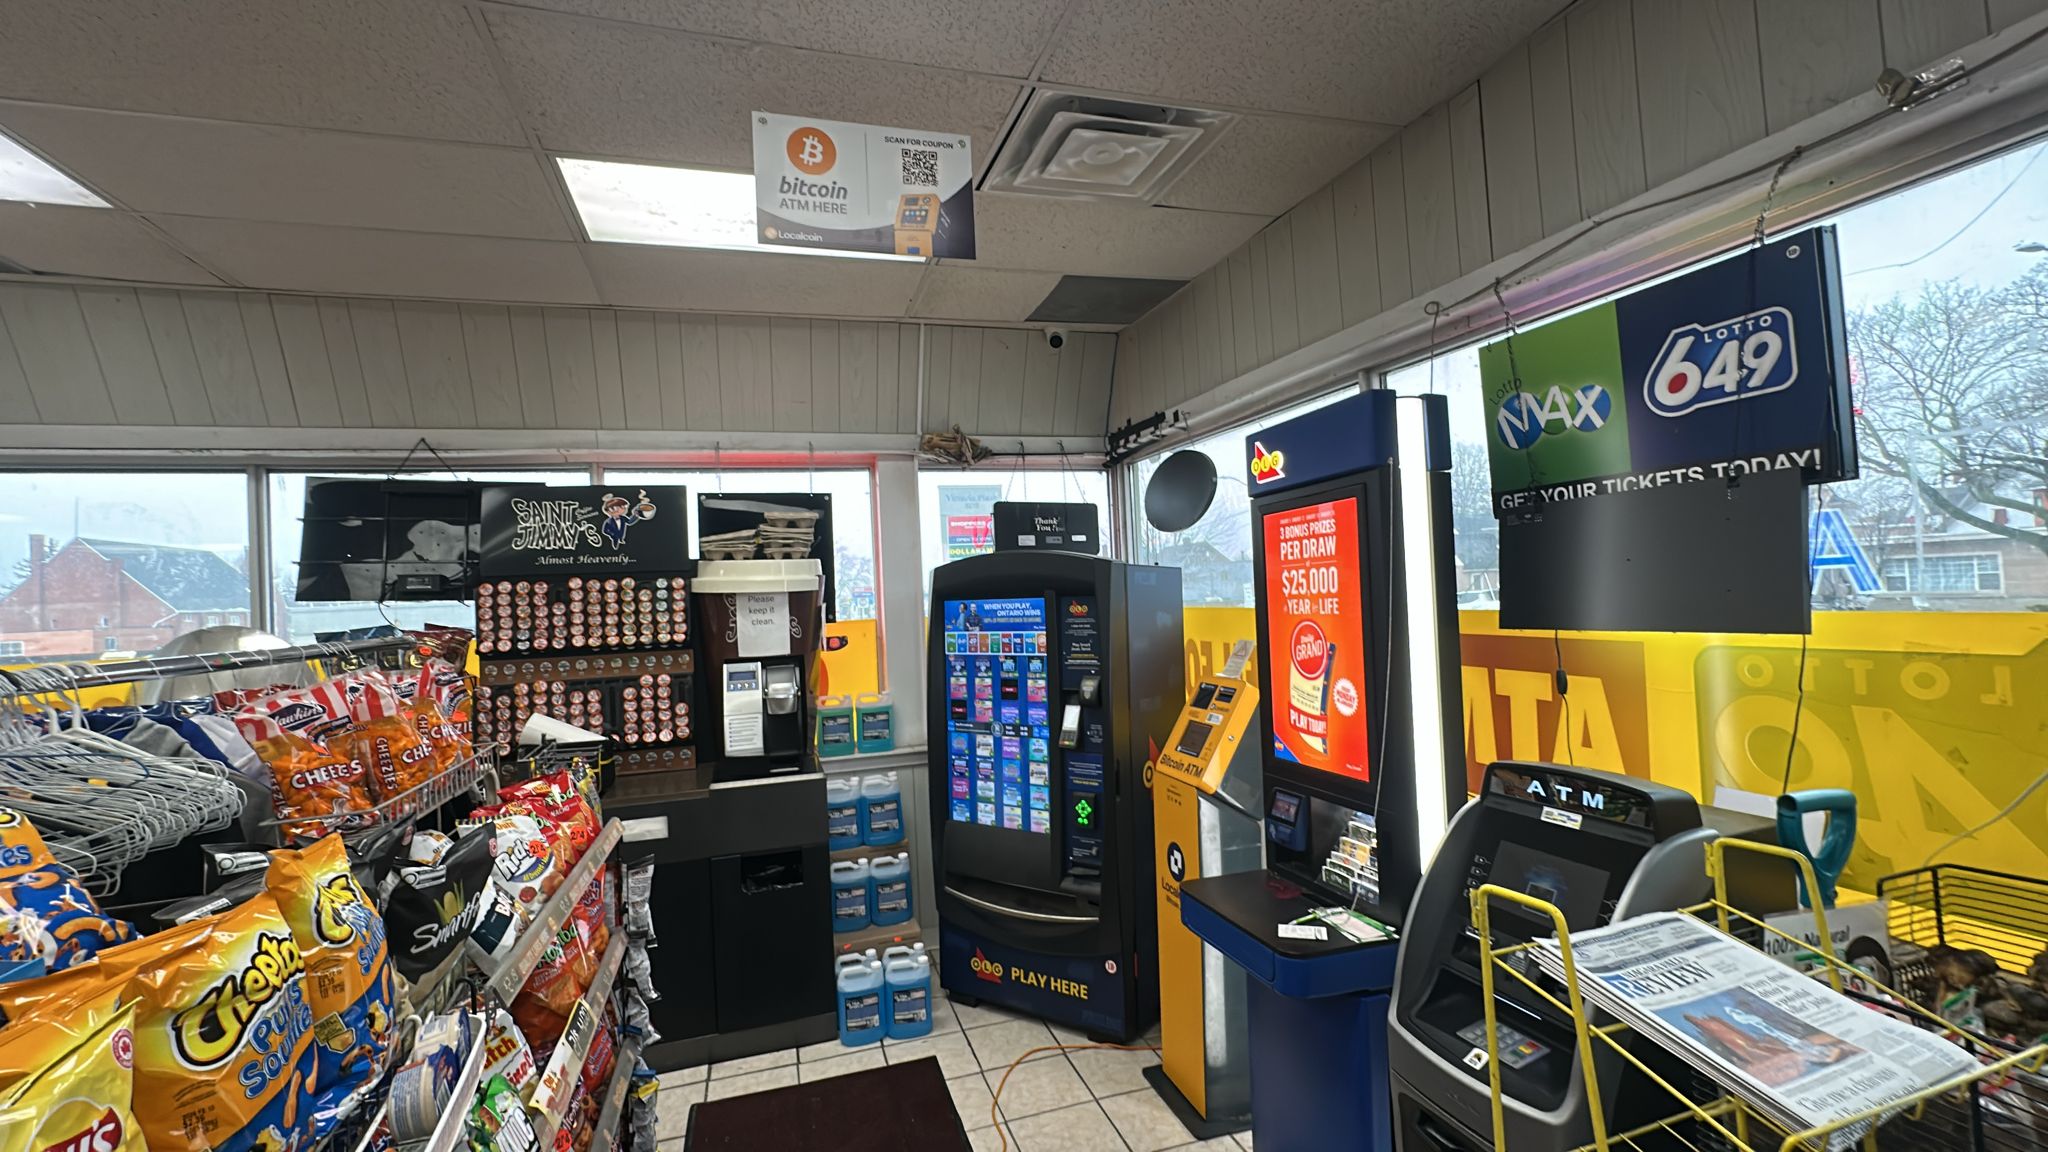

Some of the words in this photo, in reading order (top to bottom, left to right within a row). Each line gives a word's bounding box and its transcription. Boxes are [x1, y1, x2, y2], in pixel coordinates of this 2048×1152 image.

[884, 136, 905, 145] SCAN
[906, 138, 920, 147] FOR
[922, 140, 954, 149] COUPON
[778, 175, 848, 200] bitcoin
[779, 198, 810, 211] ATM
[813, 202, 847, 215] HERE
[777, 230, 823, 242] Localcoin
[1704, 315, 1773, 343] LOTTO
[1653, 330, 1783, 407] 649
[1489, 377, 1522, 407] Lotto
[1497, 384, 1605, 449] MAX
[1251, 450, 1284, 476] OLG
[1540, 482, 1598, 502] YOUR
[1602, 466, 1704, 494] TICKETS
[1711, 448, 1822, 477] TODAY!
[511, 498, 579, 525] SAINT
[1034, 517, 1059, 525] Thank
[512, 520, 602, 550] JIMMY'S
[1280, 527, 1285, 539] 3
[1285, 523, 1309, 538] BONUS
[1310, 520, 1337, 535] PRIZES
[535, 555, 574, 565] Almost
[1280, 541, 1301, 561] PER
[1303, 535, 1337, 558] DRAW
[1281, 566, 1339, 598] $25,000
[748, 595, 775, 603] Please
[748, 607, 768, 615] keep
[1287, 599, 1311, 615] YEAR
[1319, 598, 1340, 614] LIFE
[751, 618, 774, 626] clean.
[1296, 640, 1323, 662] GRAND
[1289, 708, 1308, 727] PLAY
[376, 737, 399, 790] CHEEZIES
[1160, 753, 1184, 771] Bitcoin
[1184, 761, 1204, 779] ATM
[1526, 779, 1604, 810] ATM
[970, 956, 1004, 977] OLG
[1620, 963, 1664, 979] NIAGARA
[1011, 967, 1047, 988] PLAY
[1050, 976, 1088, 1000] HERE
[1606, 961, 1715, 999] REVIEW
